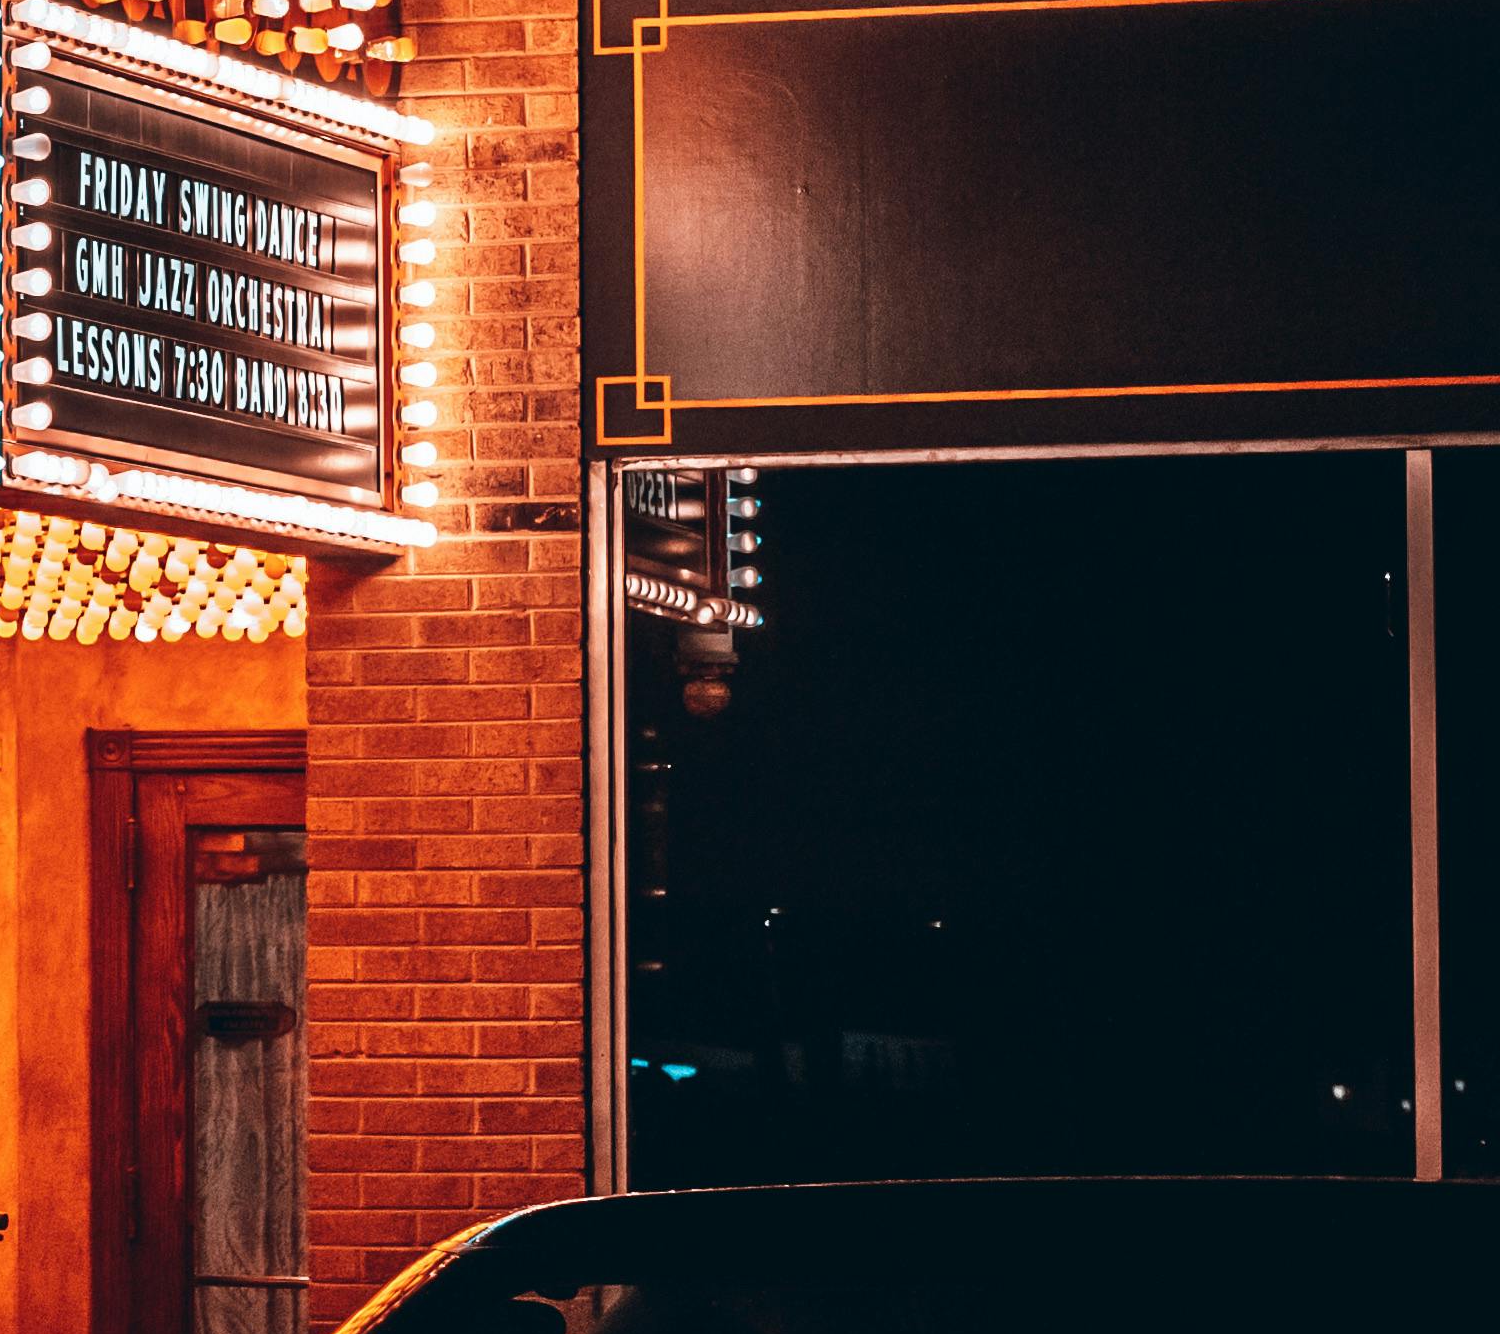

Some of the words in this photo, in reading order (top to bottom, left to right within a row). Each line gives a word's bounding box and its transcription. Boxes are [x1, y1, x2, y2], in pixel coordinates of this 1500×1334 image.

[79, 152, 167, 225] FRIDAY
[180, 182, 247, 249] SWING
[256, 203, 319, 268] DANCE
[76, 238, 124, 299] GMH
[139, 256, 197, 319] JAZZ
[208, 269, 323, 349] ORCHESTRA
[56, 316, 162, 394] LESSONS
[174, 345, 225, 405] 7:30
[236, 360, 287, 420] BAND
[297, 378, 344, 433] 8:30
